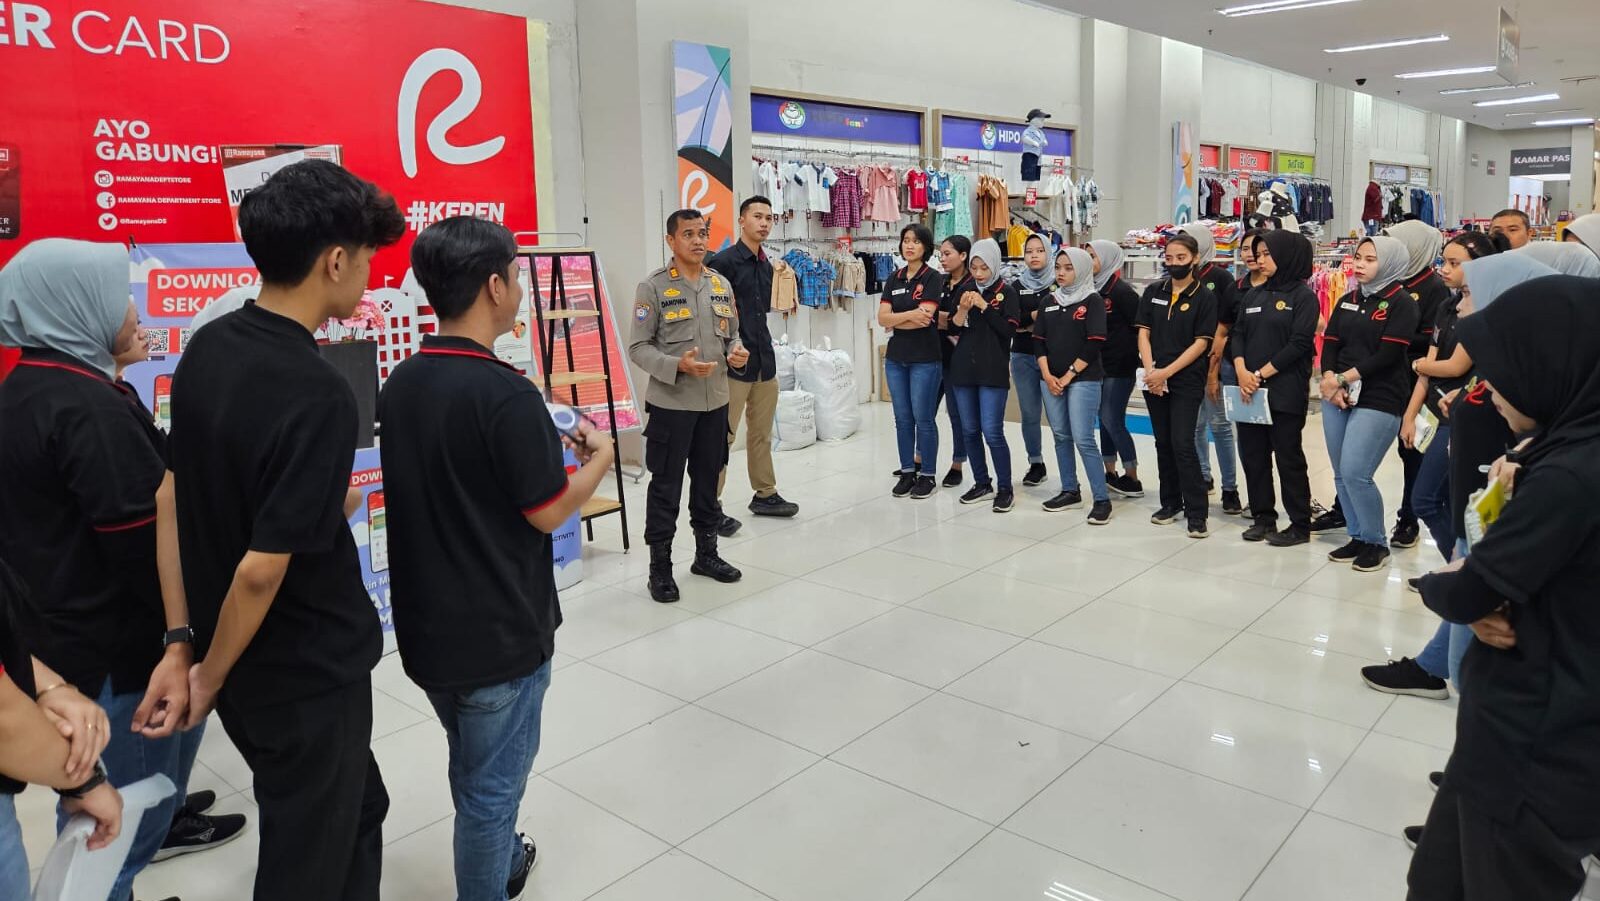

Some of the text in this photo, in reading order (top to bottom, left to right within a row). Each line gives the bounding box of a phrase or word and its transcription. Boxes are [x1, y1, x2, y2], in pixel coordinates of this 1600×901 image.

[71, 10, 231, 64] CARD
[93, 119, 150, 138] AYO
[999, 129, 1020, 144] HIPO
[96, 141, 219, 164] GABUNG!
[1513, 154, 1571, 164] KAMAR PAS
[118, 196, 157, 204] RAMAYANA
[710, 295, 729, 303] POLRI
